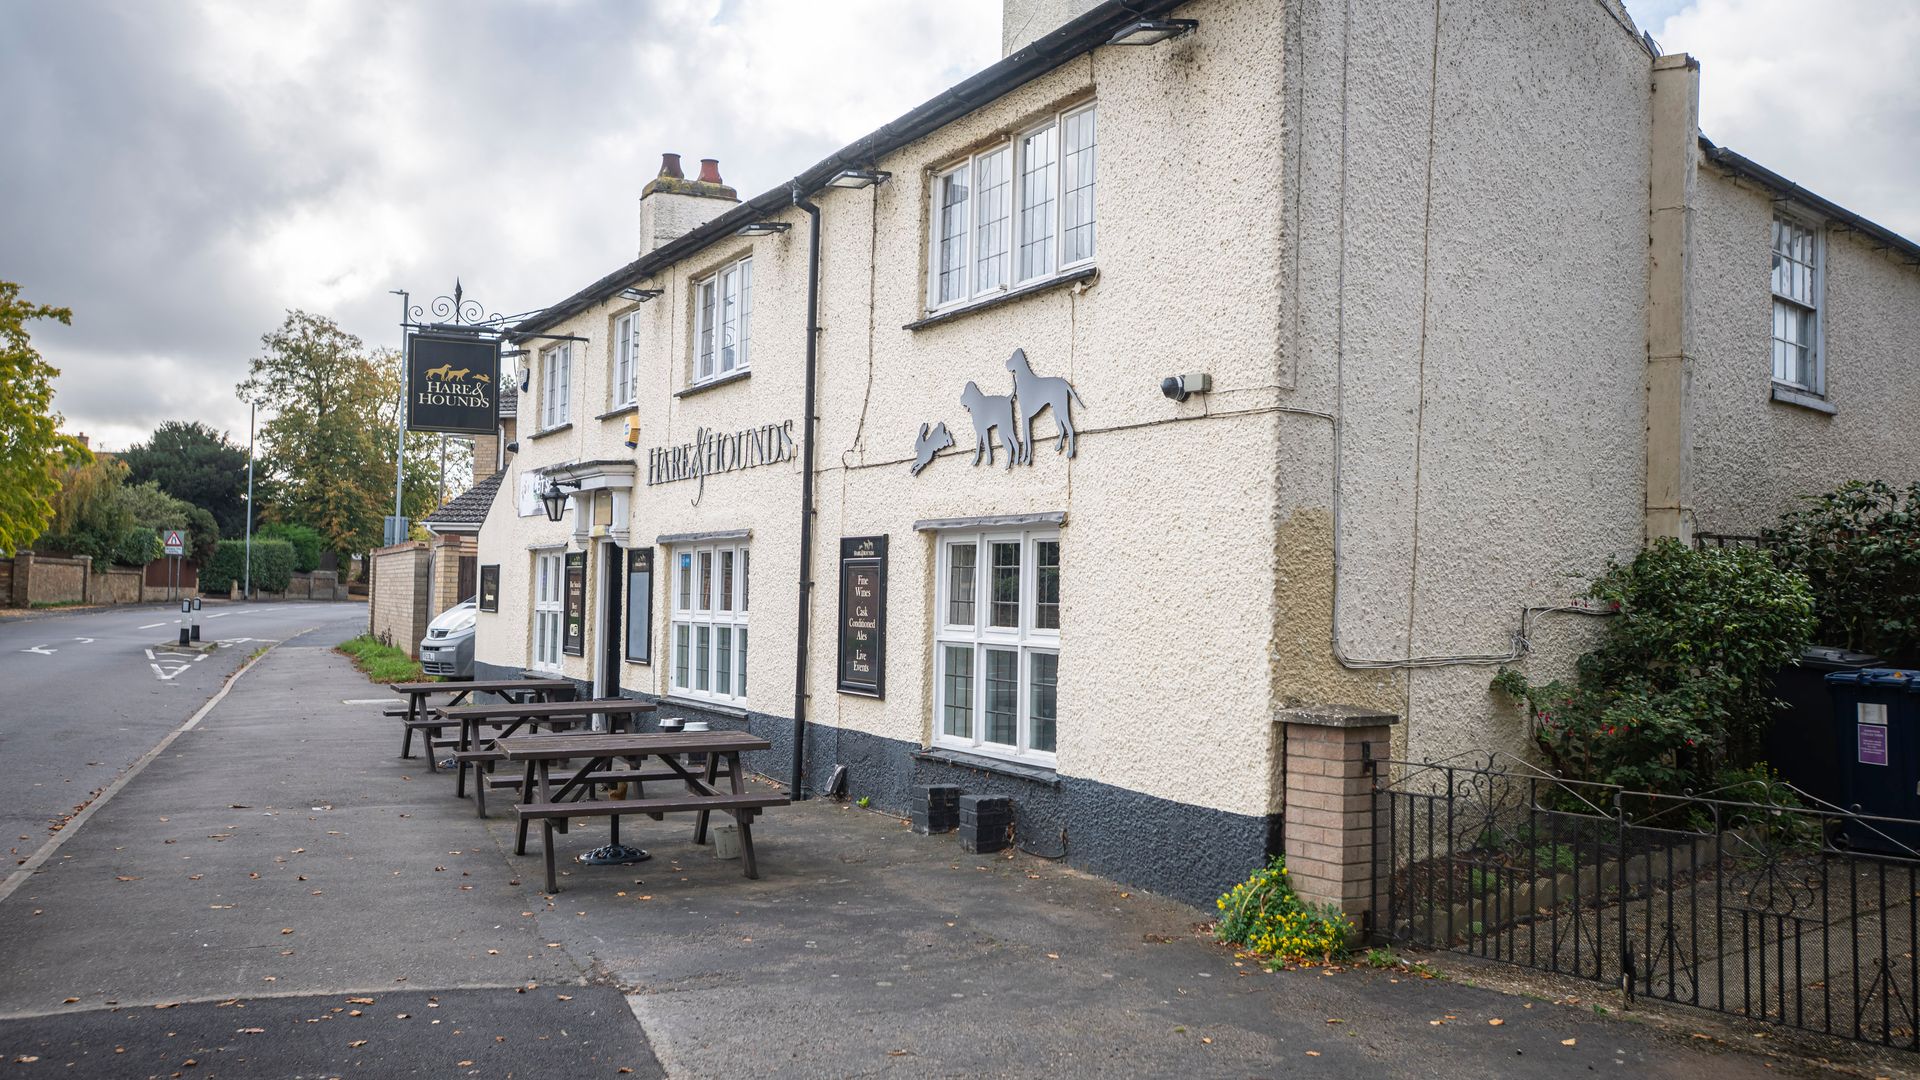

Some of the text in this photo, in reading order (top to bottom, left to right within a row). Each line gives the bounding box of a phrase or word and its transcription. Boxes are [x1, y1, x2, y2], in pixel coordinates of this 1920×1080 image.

[418, 393, 490, 409] HOUNDS
[857, 574, 869, 585] Fine
[855, 586, 871, 598] Wines
[856, 605, 868, 617] Cask
[848, 617, 876, 629] Conditioned
[856, 630, 868, 641] Ales
[856, 649, 867, 661] Live
[853, 660, 870, 673] Events
